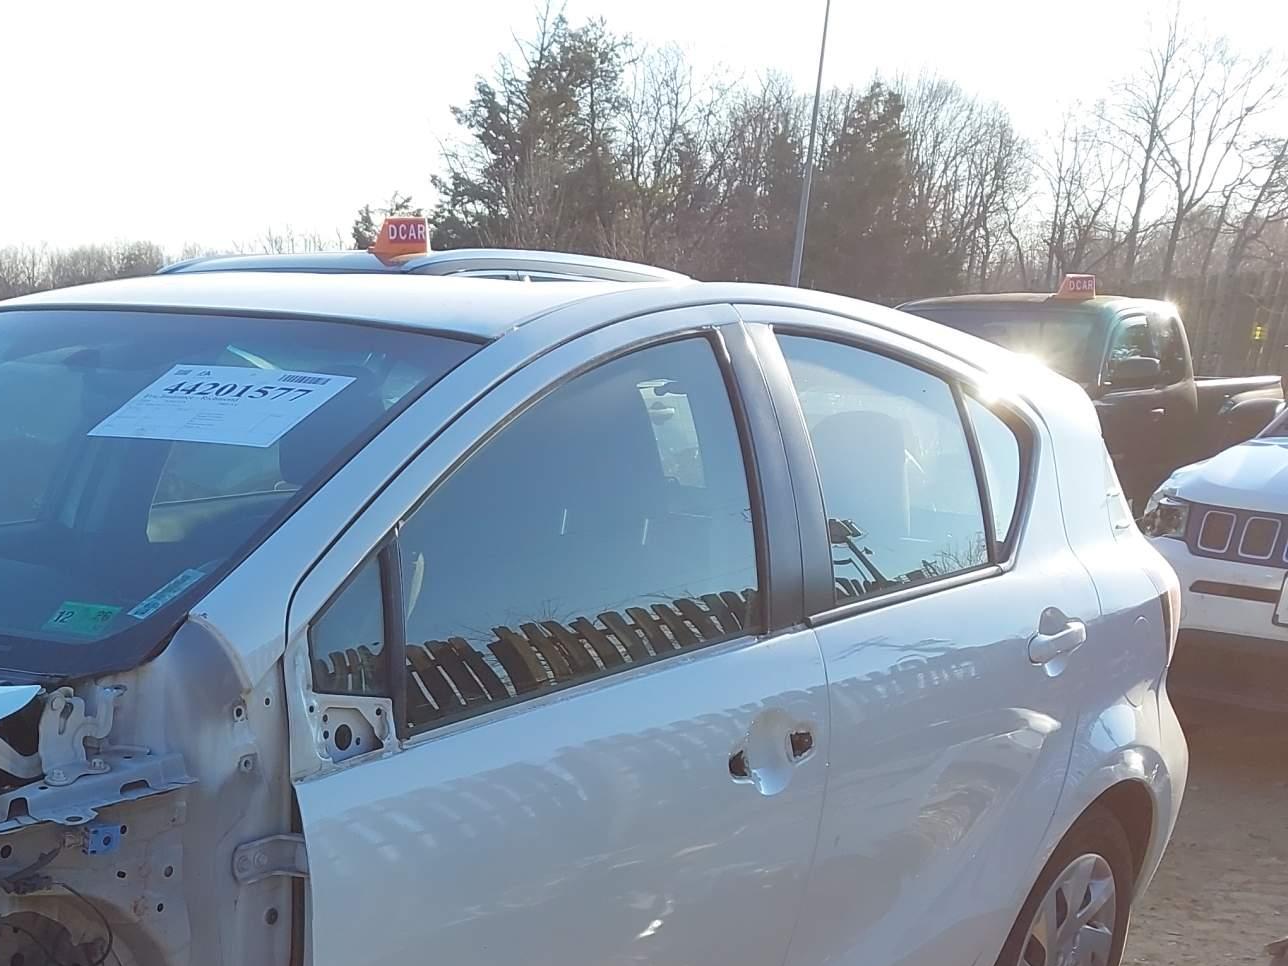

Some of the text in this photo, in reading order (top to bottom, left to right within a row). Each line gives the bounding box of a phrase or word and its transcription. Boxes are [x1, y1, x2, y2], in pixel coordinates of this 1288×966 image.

[388, 223, 425, 241] DCAR
[1069, 279, 1093, 290] DCAR
[162, 381, 314, 402] 44201577
[53, 610, 75, 624] 12
